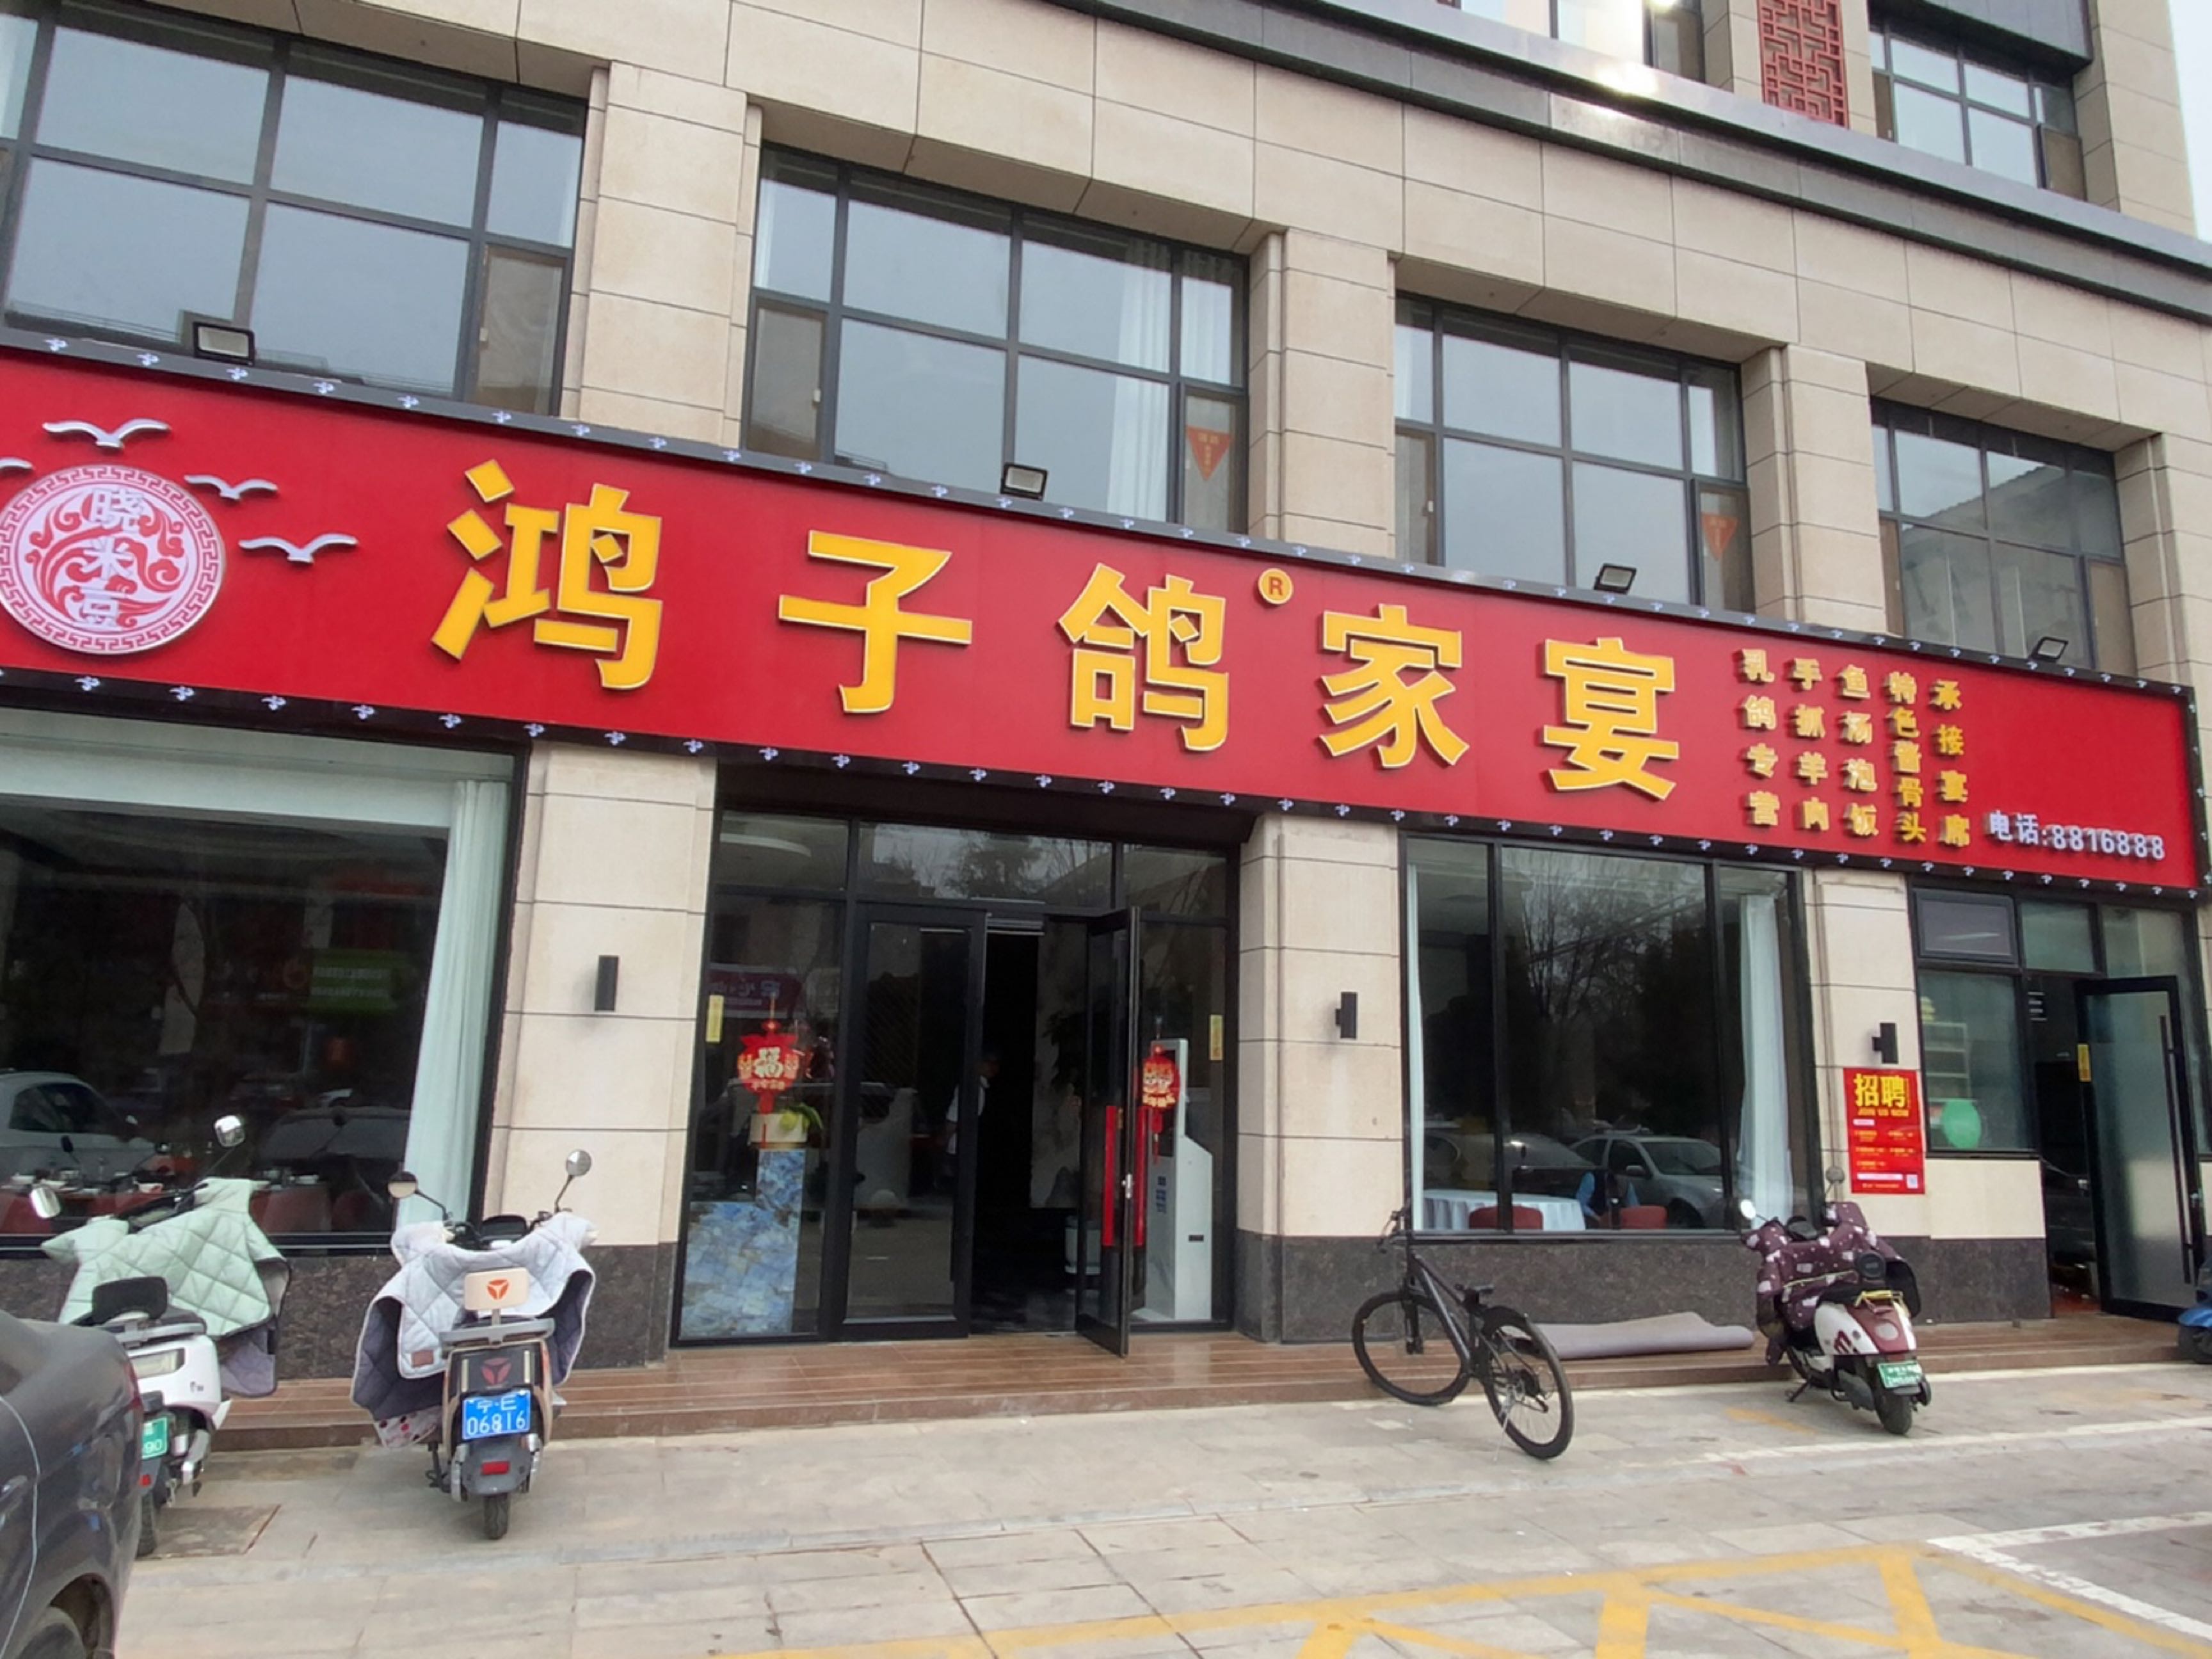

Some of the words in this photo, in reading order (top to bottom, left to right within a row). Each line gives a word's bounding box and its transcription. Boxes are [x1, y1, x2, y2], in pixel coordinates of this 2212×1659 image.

[433, 461, 1681, 800] 鸿子鸽家宴
[1741, 648, 1780, 826] 乳鸽专营
[1791, 658, 1829, 831] 手抓羊肉
[1932, 680, 1971, 847] 承接宴席
[1988, 810, 2165, 860] 电话:8816888
[1853, 1073, 1905, 1107] 招聘
[466, 1410, 525, 1436] 06816
